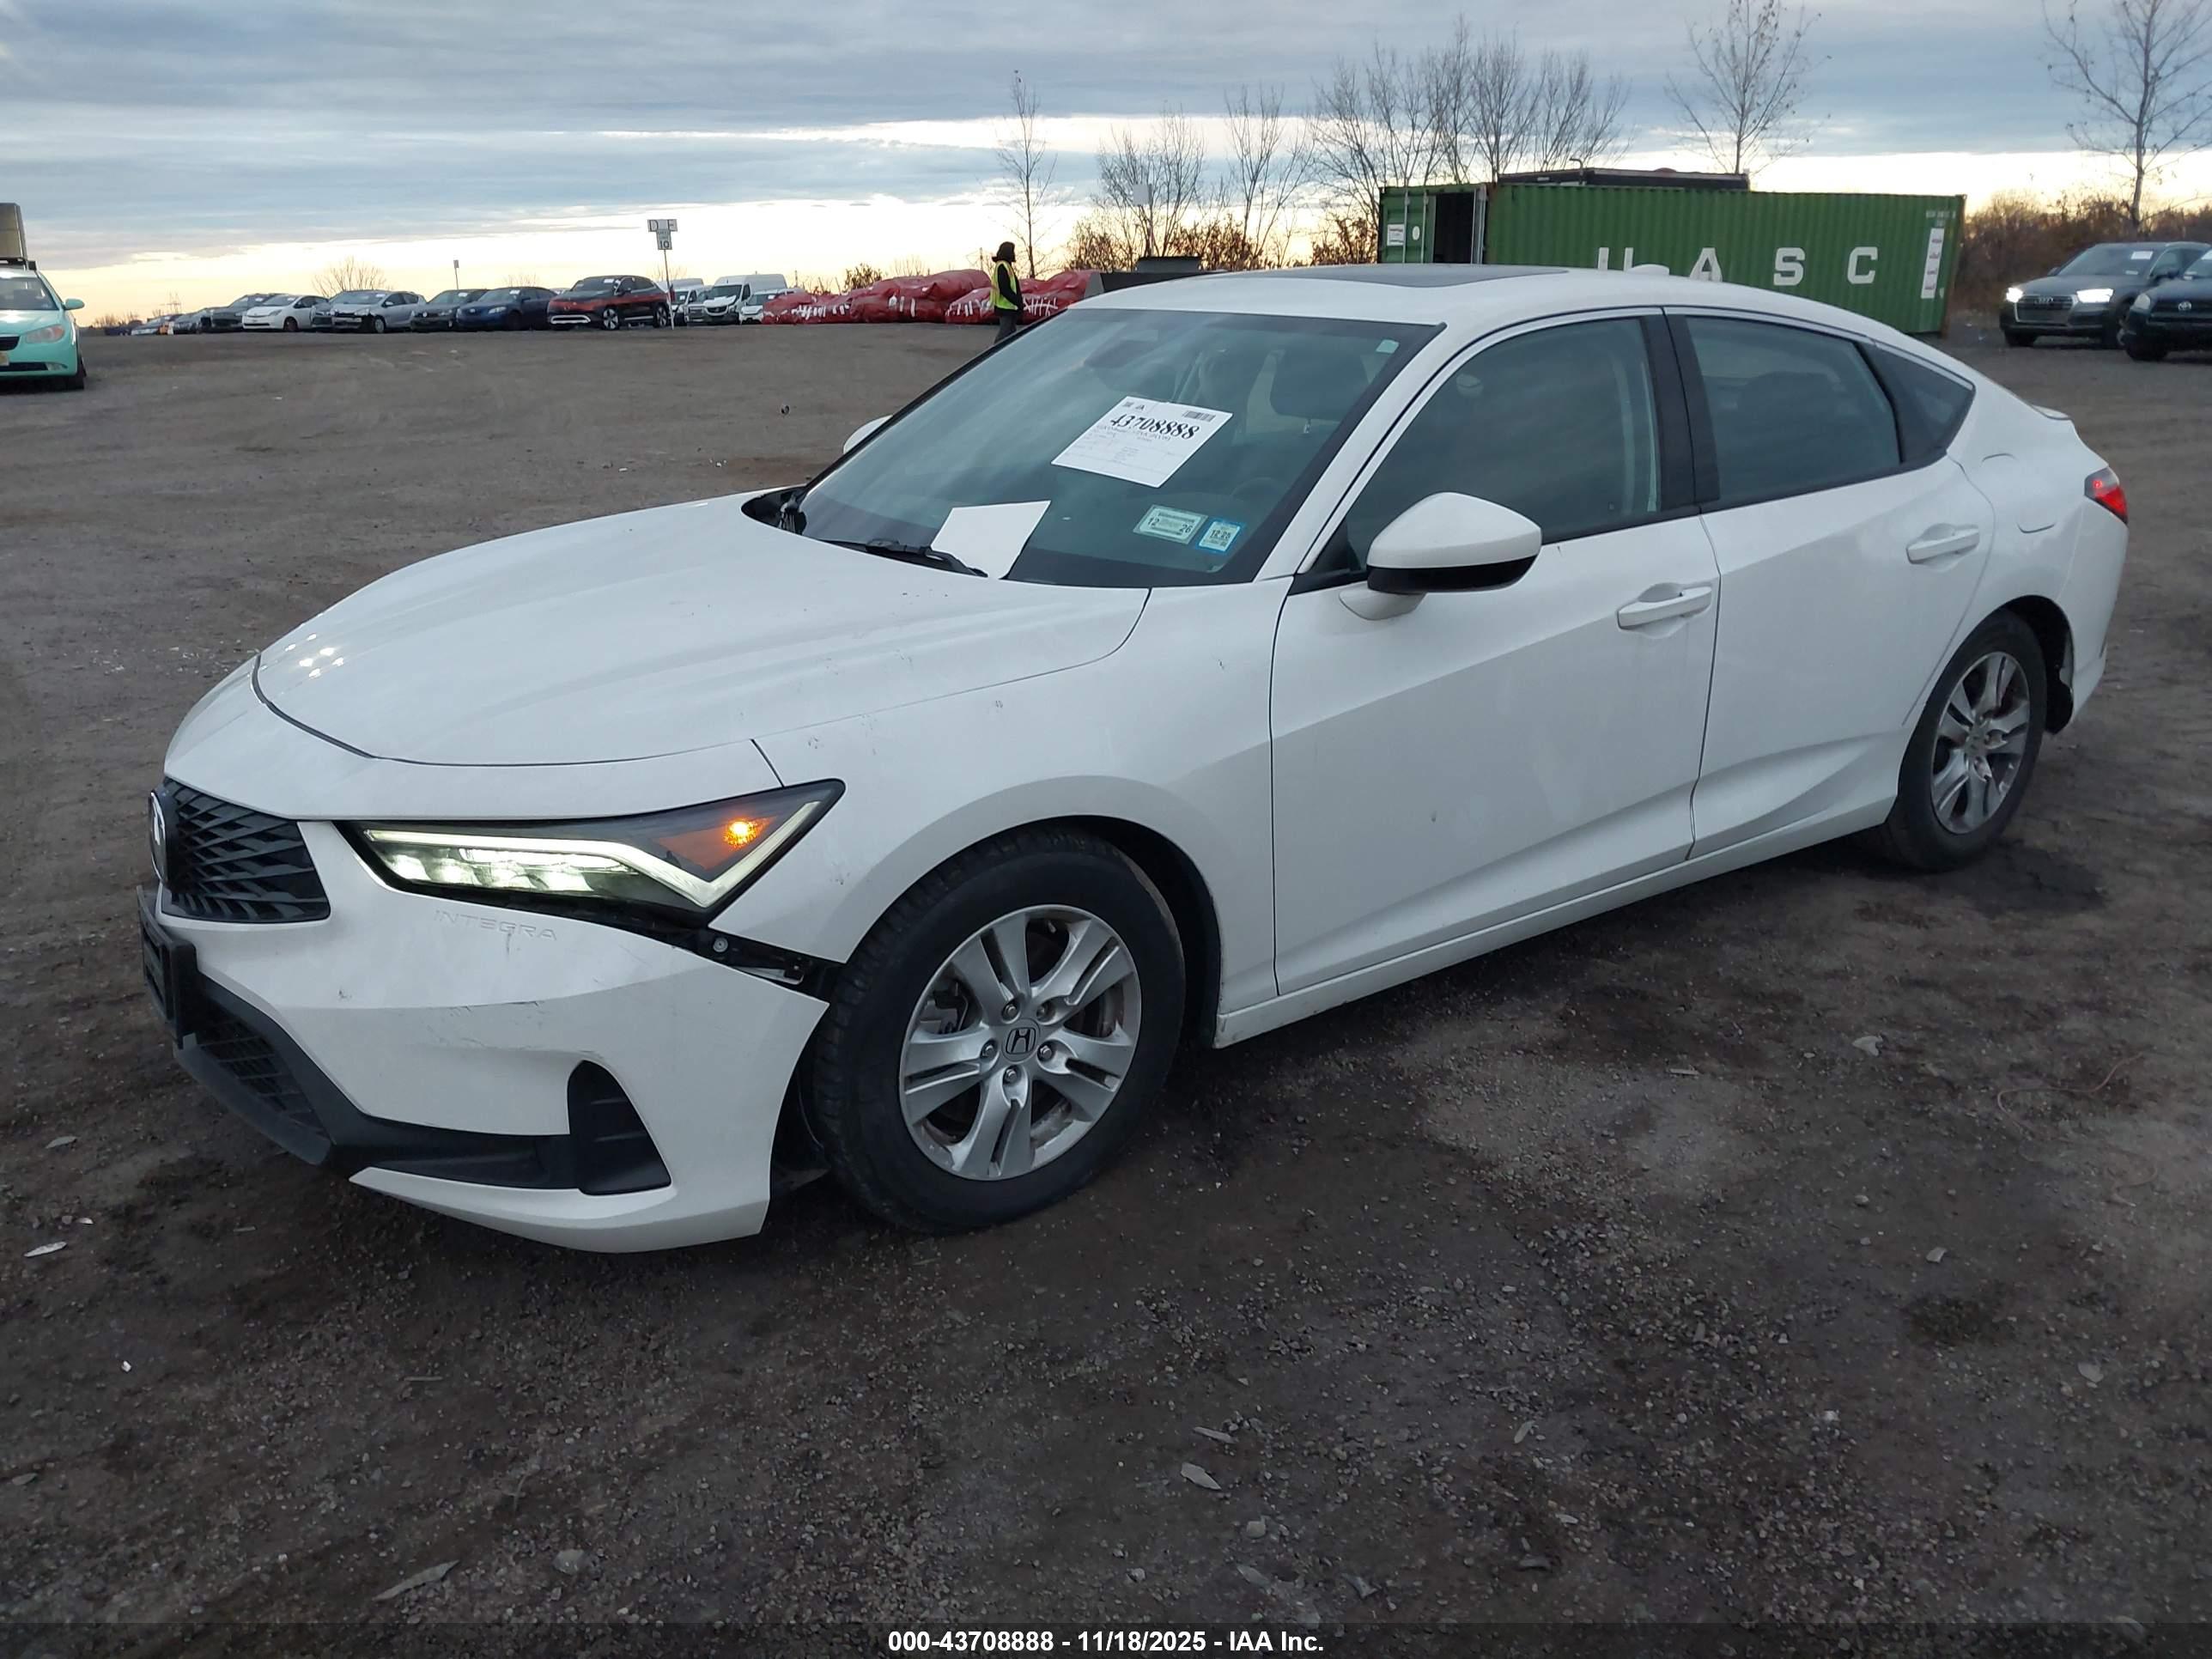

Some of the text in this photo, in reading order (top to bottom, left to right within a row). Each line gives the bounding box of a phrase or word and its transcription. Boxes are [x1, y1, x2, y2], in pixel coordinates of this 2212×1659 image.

[659, 240, 670, 249] 10
[1597, 246, 1878, 286] UASC
[1110, 413, 1200, 440] 43708888
[1148, 517, 1160, 526] 12
[433, 910, 557, 941] INTEGRA
